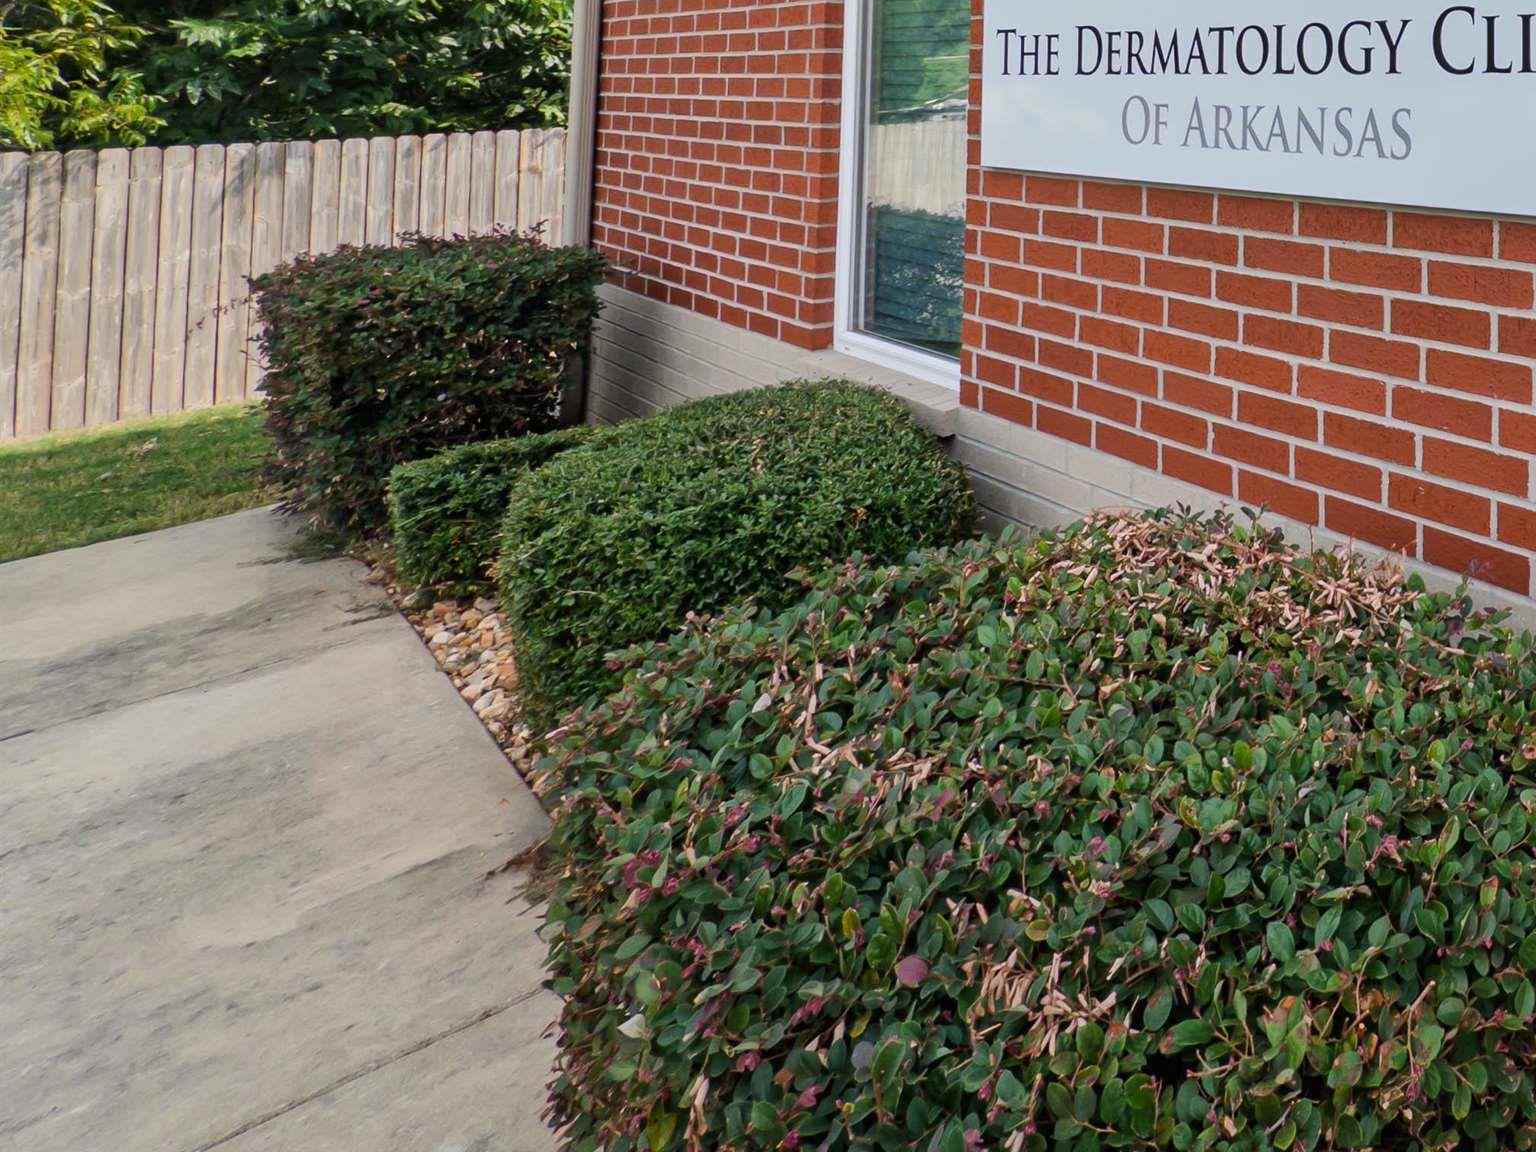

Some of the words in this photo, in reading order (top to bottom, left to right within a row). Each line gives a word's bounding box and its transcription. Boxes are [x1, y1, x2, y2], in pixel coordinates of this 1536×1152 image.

[996, 27, 1060, 77] THE
[1074, 18, 1413, 76] DERMATOLOGY
[1120, 94, 1169, 147] OF
[1179, 95, 1413, 161] ARKANSAS
